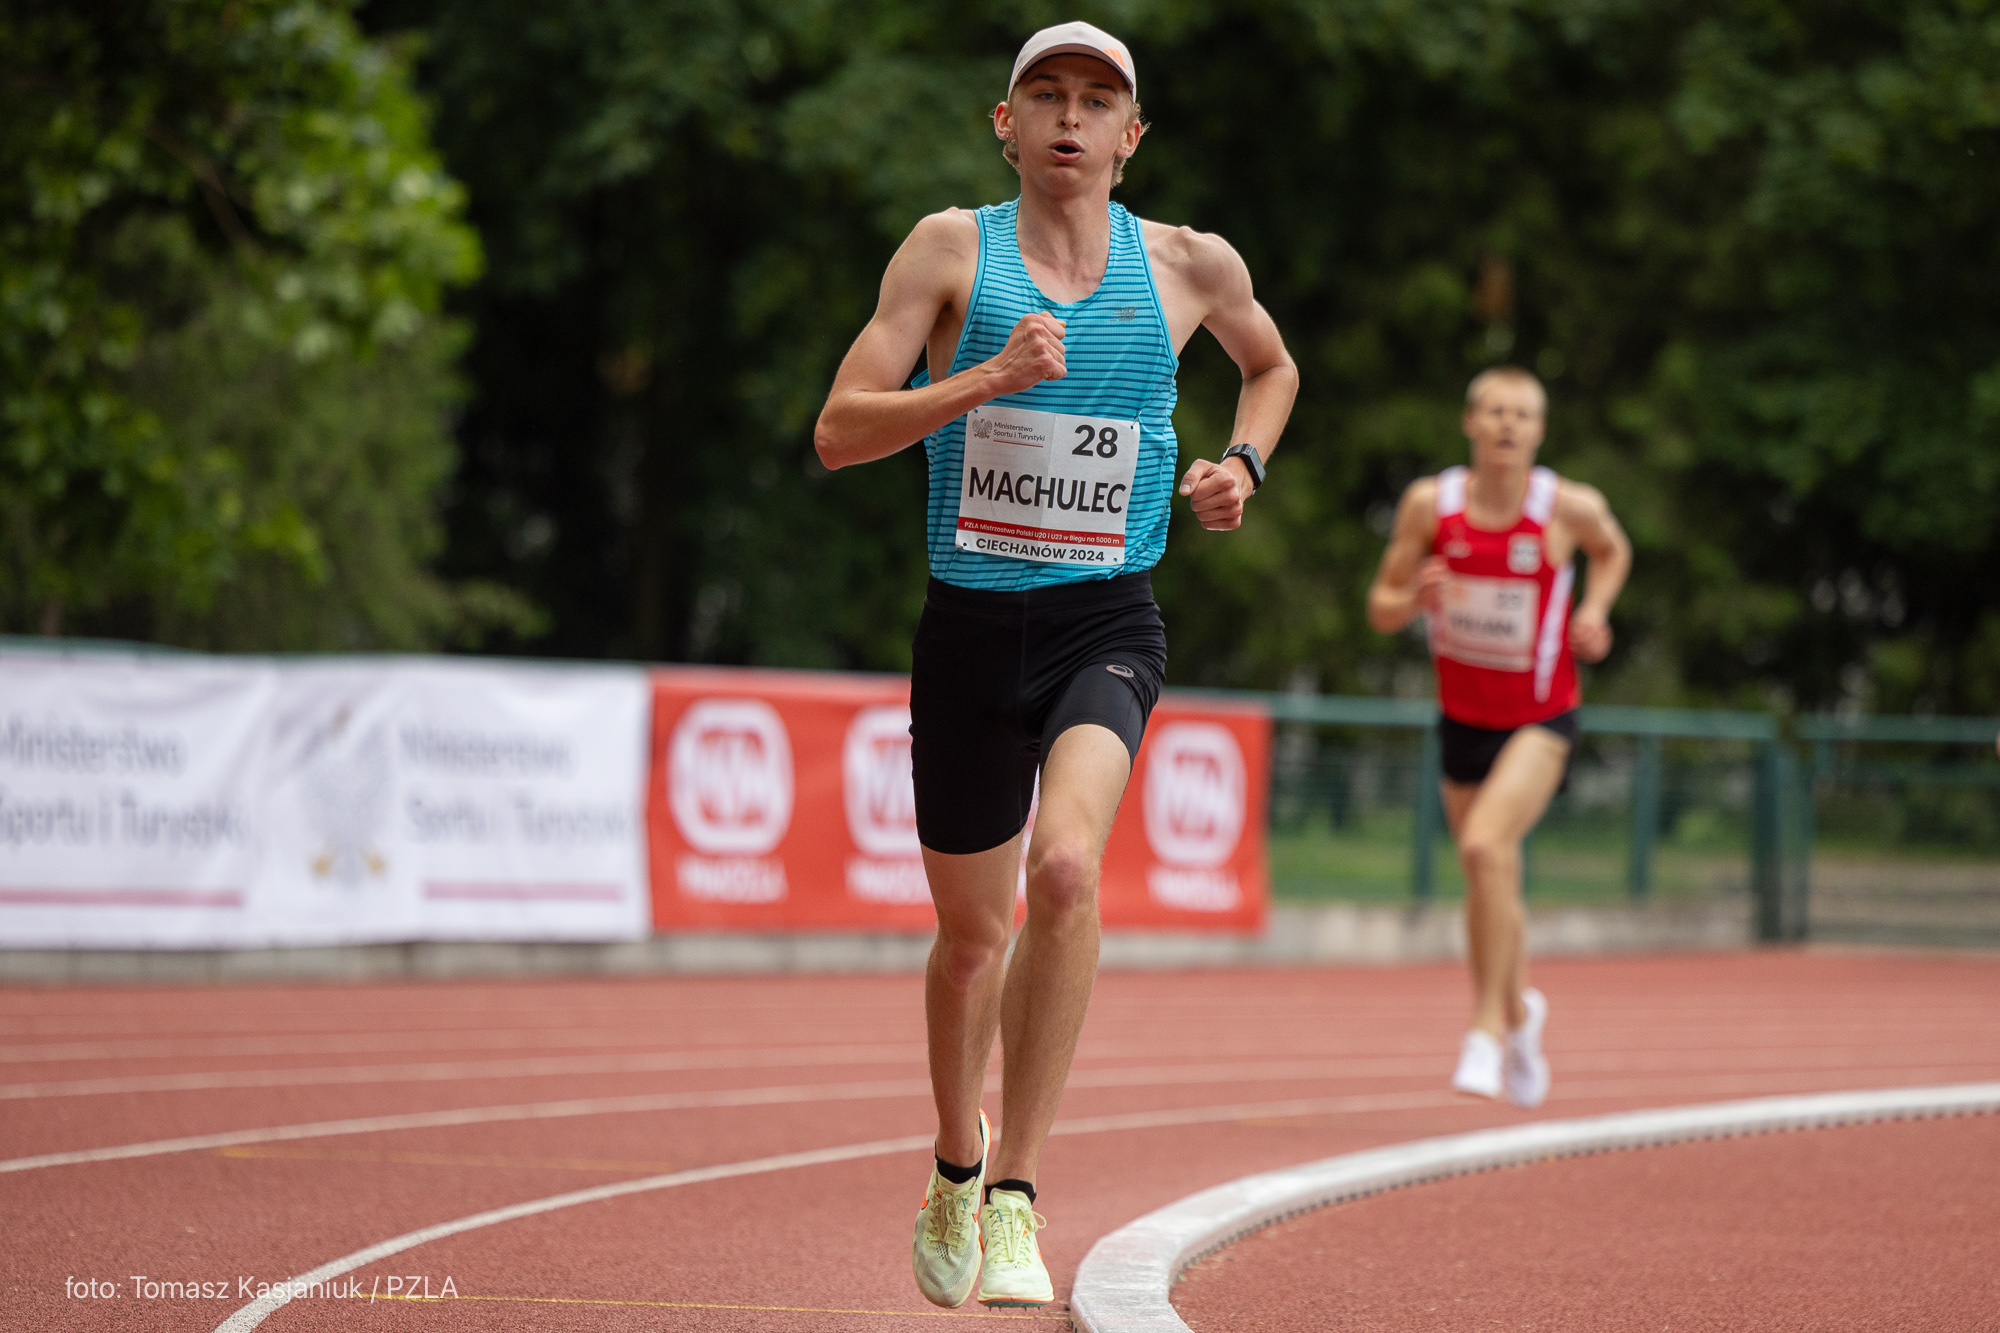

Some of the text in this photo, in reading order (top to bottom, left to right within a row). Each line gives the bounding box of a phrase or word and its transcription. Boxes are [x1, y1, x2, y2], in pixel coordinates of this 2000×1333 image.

[993, 421, 1033, 432] Ministerstwo
[993, 429, 1013, 439] Sportu
[1018, 432, 1045, 441] Turystyki
[1071, 424, 1119, 458] 28
[968, 466, 1127, 514] MACHULEC
[964, 521, 979, 530] PZLA
[980, 523, 1015, 535] Mistrzostwa
[1016, 529, 1033, 537] Polski
[1051, 533, 1062, 541] U23
[1069, 535, 1086, 543] Biegu
[976, 538, 1105, 562] CIECHANÓW 2024
